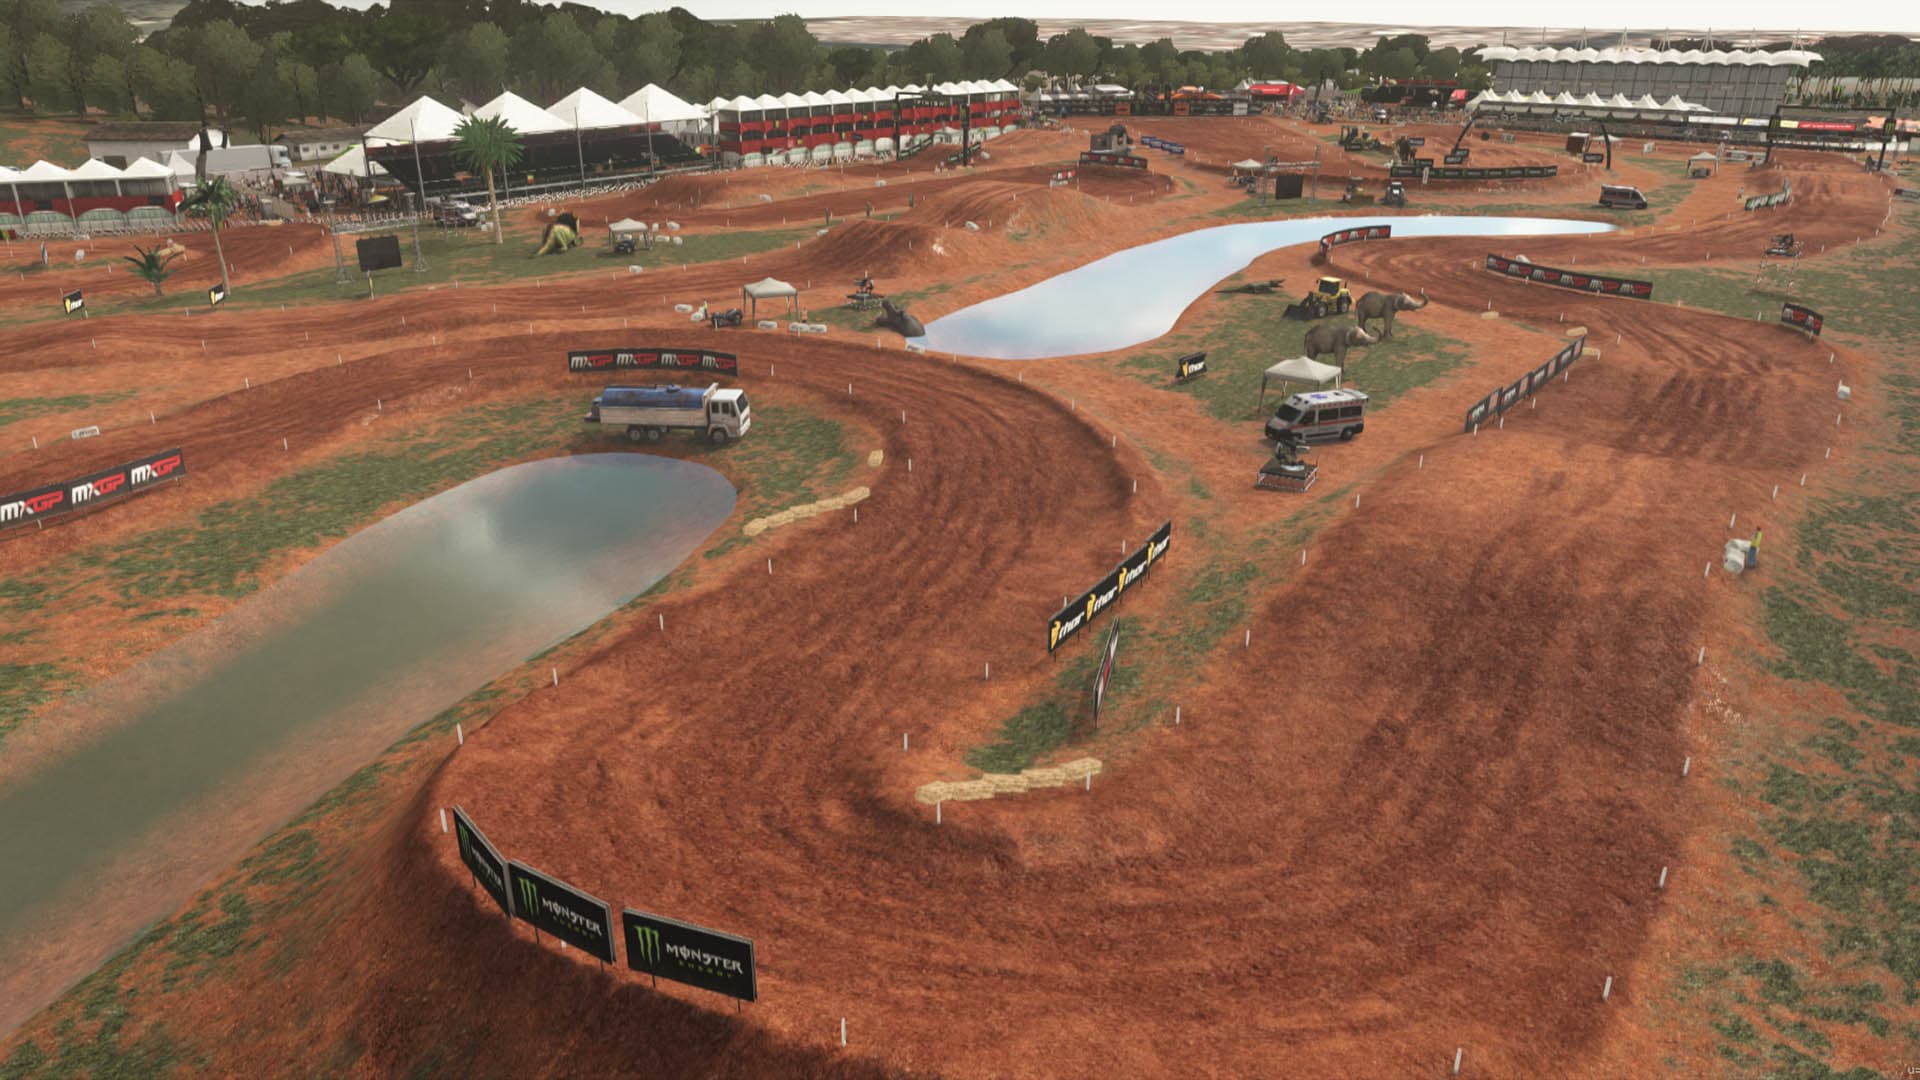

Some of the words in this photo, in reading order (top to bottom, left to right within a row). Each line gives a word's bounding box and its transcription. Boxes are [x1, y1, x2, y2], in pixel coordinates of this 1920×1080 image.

[0, 490, 64, 522] MXGP
[71, 472, 126, 504] MXGP
[131, 454, 181, 485] MXGP
[541, 896, 602, 937] MONSTER
[665, 943, 744, 975] MONSTER
